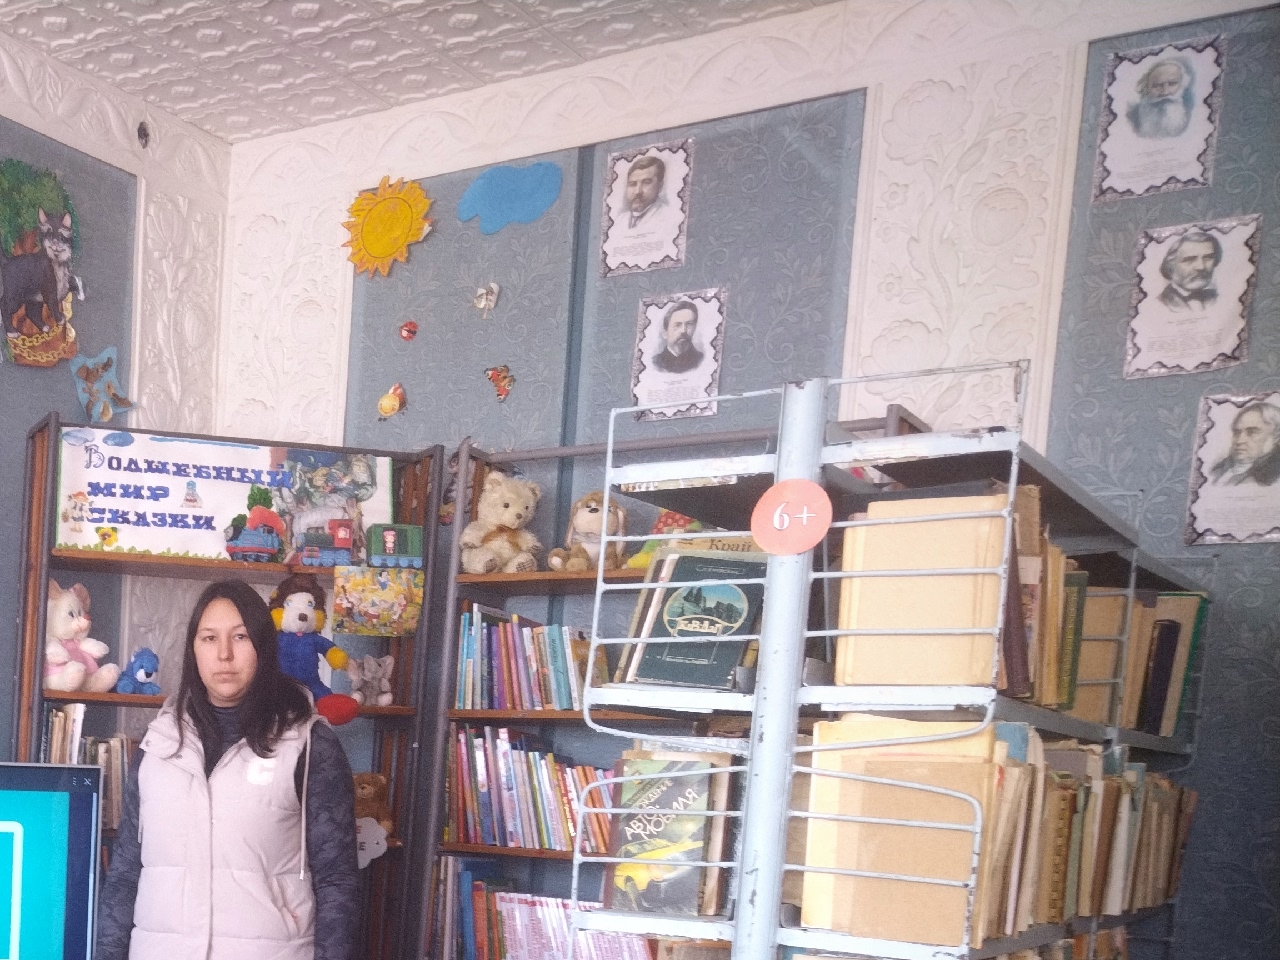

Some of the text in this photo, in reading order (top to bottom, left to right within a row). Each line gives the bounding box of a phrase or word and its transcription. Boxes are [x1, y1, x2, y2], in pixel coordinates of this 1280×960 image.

[87, 481, 170, 502] МИР
[86, 506, 217, 531] СКАЗКИ
[772, 501, 817, 531] 6+
